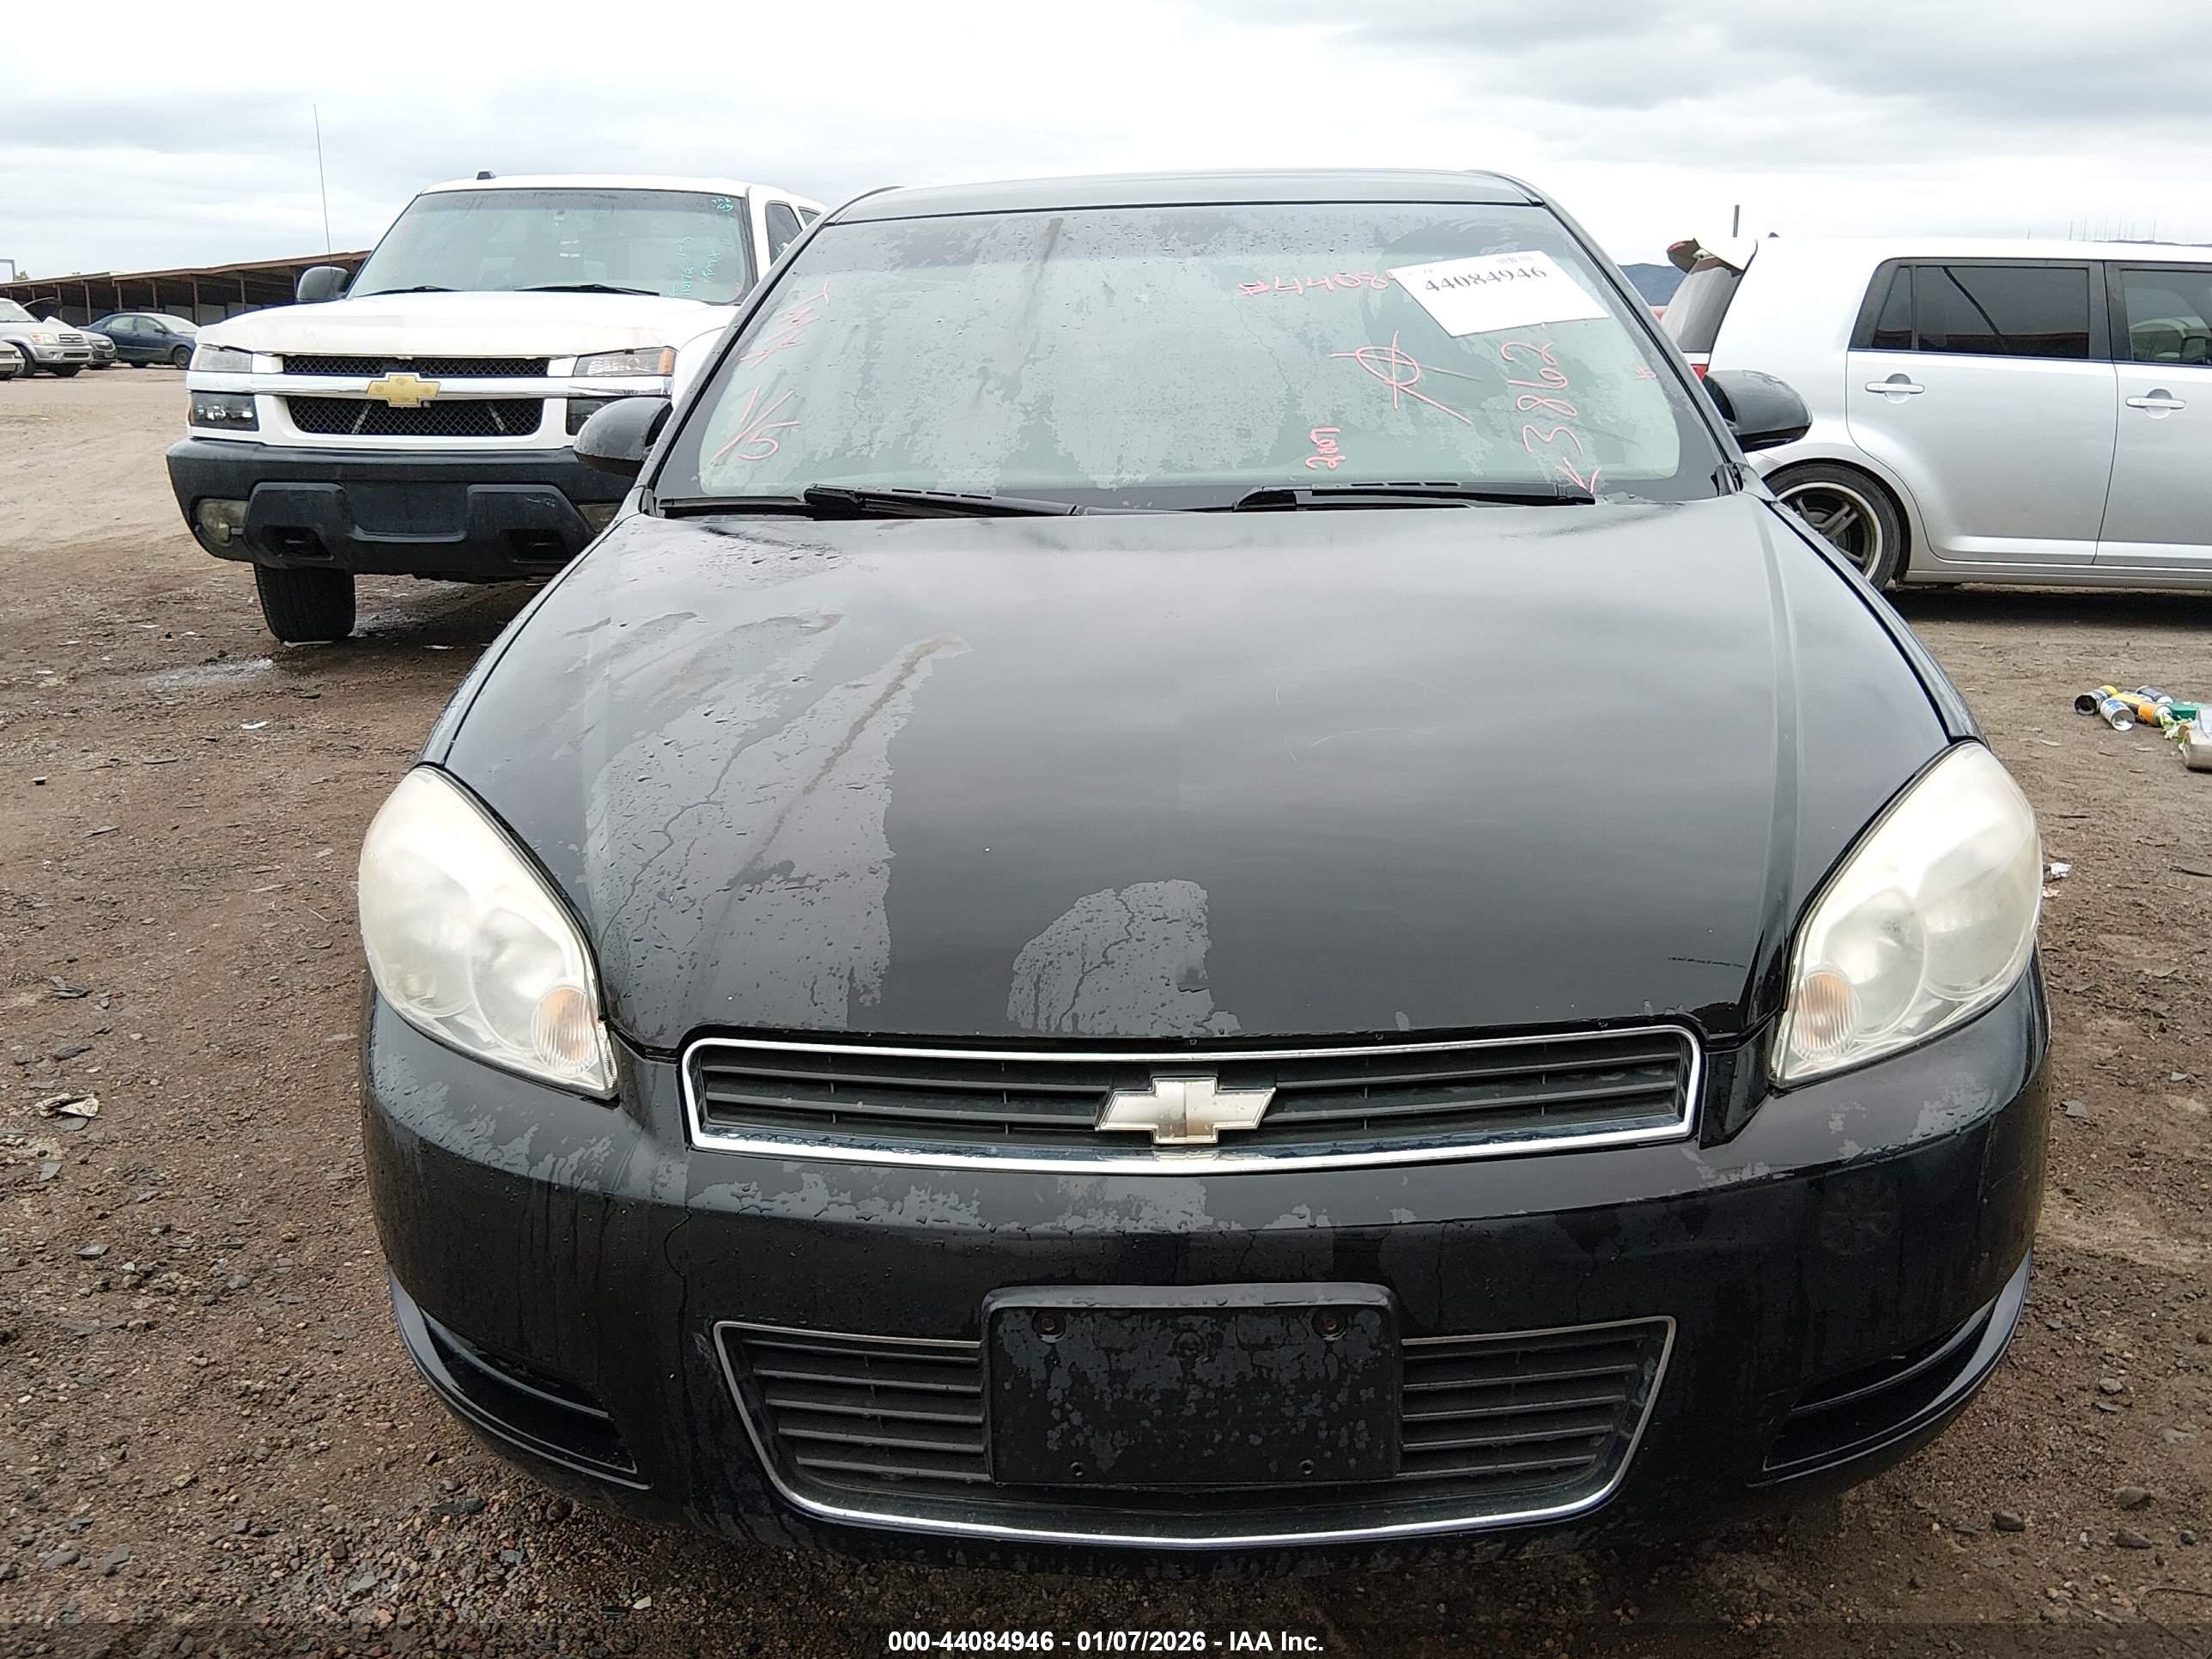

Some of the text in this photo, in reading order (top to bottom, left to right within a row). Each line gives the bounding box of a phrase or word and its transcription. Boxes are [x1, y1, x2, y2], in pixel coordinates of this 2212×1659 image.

[1238, 269, 1397, 296] #4408
[1425, 266, 1547, 291] 44084946
[1500, 342, 1583, 454] 3862
